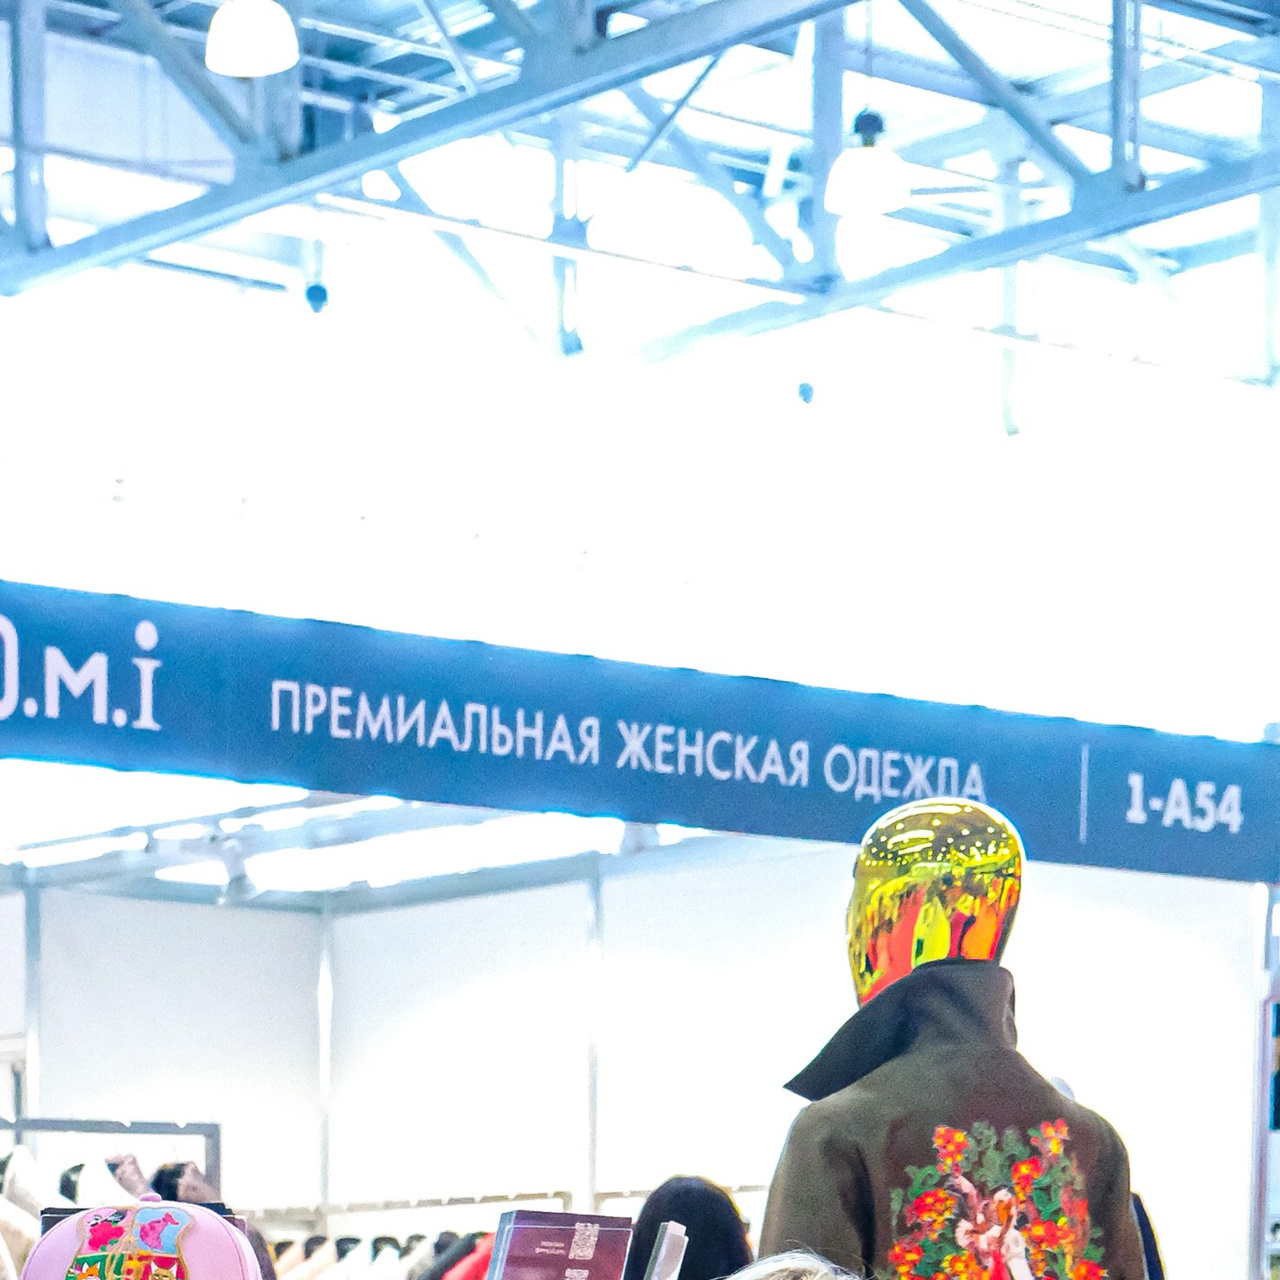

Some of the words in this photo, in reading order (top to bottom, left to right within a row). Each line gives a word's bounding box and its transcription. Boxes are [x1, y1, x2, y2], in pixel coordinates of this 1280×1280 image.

[271, 680, 600, 766] ПРЕМИАЛЬНАЯ
[616, 719, 809, 788] ЖЕНСКАЯ
[1126, 771, 1244, 834] 1-A54
